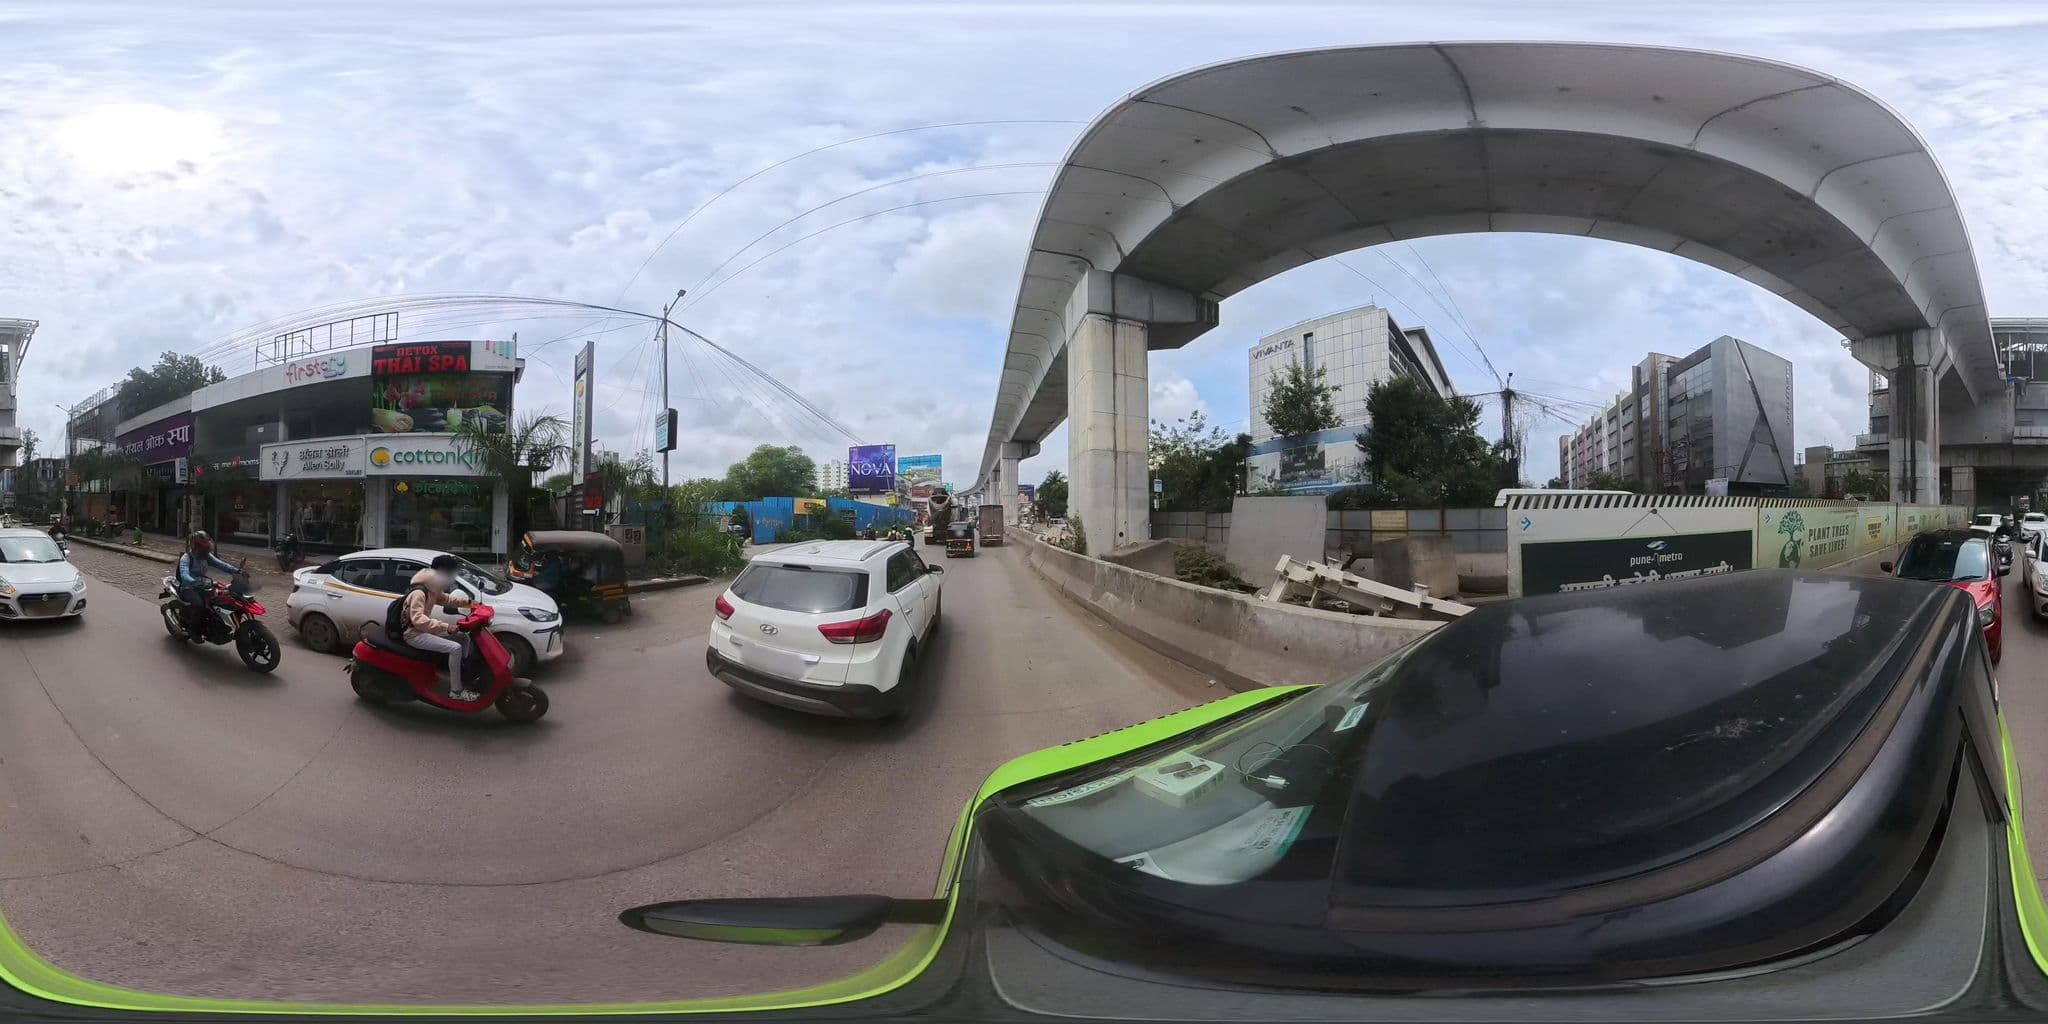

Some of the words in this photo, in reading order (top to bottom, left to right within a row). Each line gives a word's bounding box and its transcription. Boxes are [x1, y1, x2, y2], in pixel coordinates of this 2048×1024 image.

[396, 345, 438, 357] DETOX
[1252, 340, 1295, 359] VIVANTA
[374, 356, 422, 376] THAI
[429, 355, 467, 372] SPA
[166, 425, 190, 445] स्पा
[302, 461, 322, 472] Allen
[851, 463, 891, 476] NOVA
[1808, 526, 1830, 542] PLANT
[1832, 524, 1849, 537] TREES
[1659, 552, 1683, 563] metro
[1809, 543, 1827, 558] SAVE
